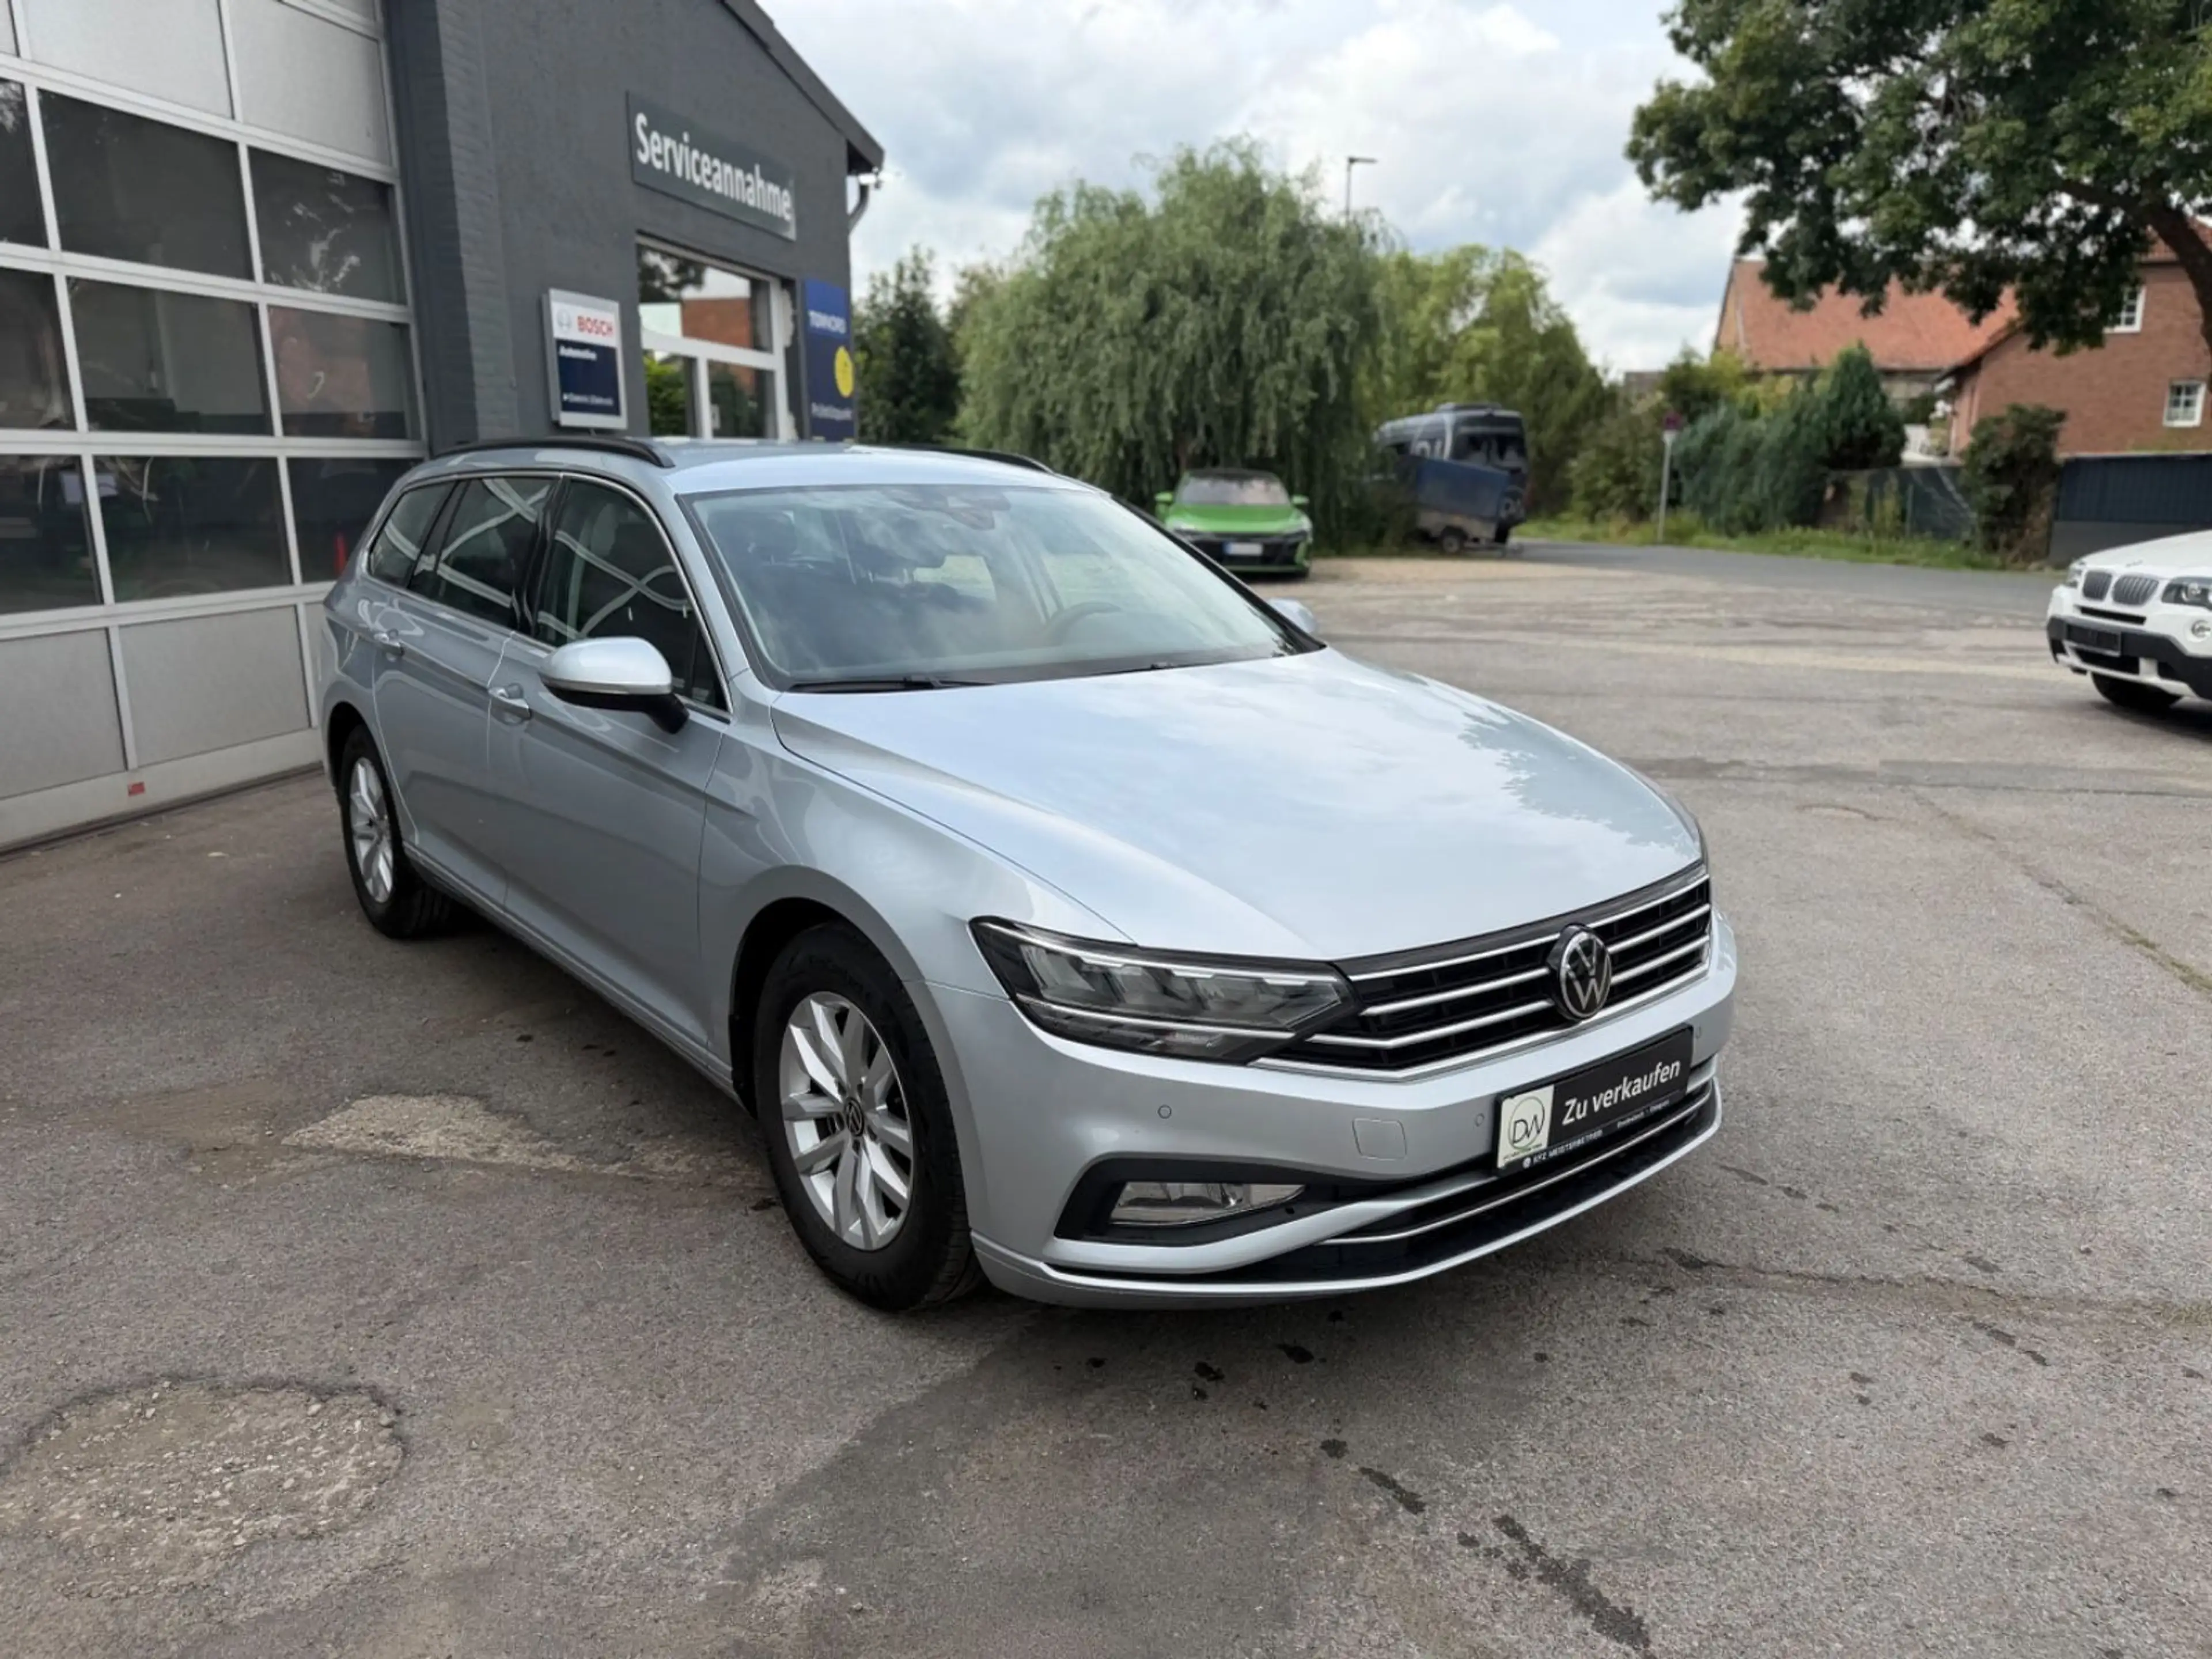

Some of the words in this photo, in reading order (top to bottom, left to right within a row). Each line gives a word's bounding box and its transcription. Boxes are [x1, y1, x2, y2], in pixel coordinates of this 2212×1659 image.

[635, 112, 791, 221] Serviceannahme
[577, 315, 613, 338] BOSCH
[1562, 1097, 1587, 1126] Zu
[1592, 1059, 1681, 1113] verkaufen
